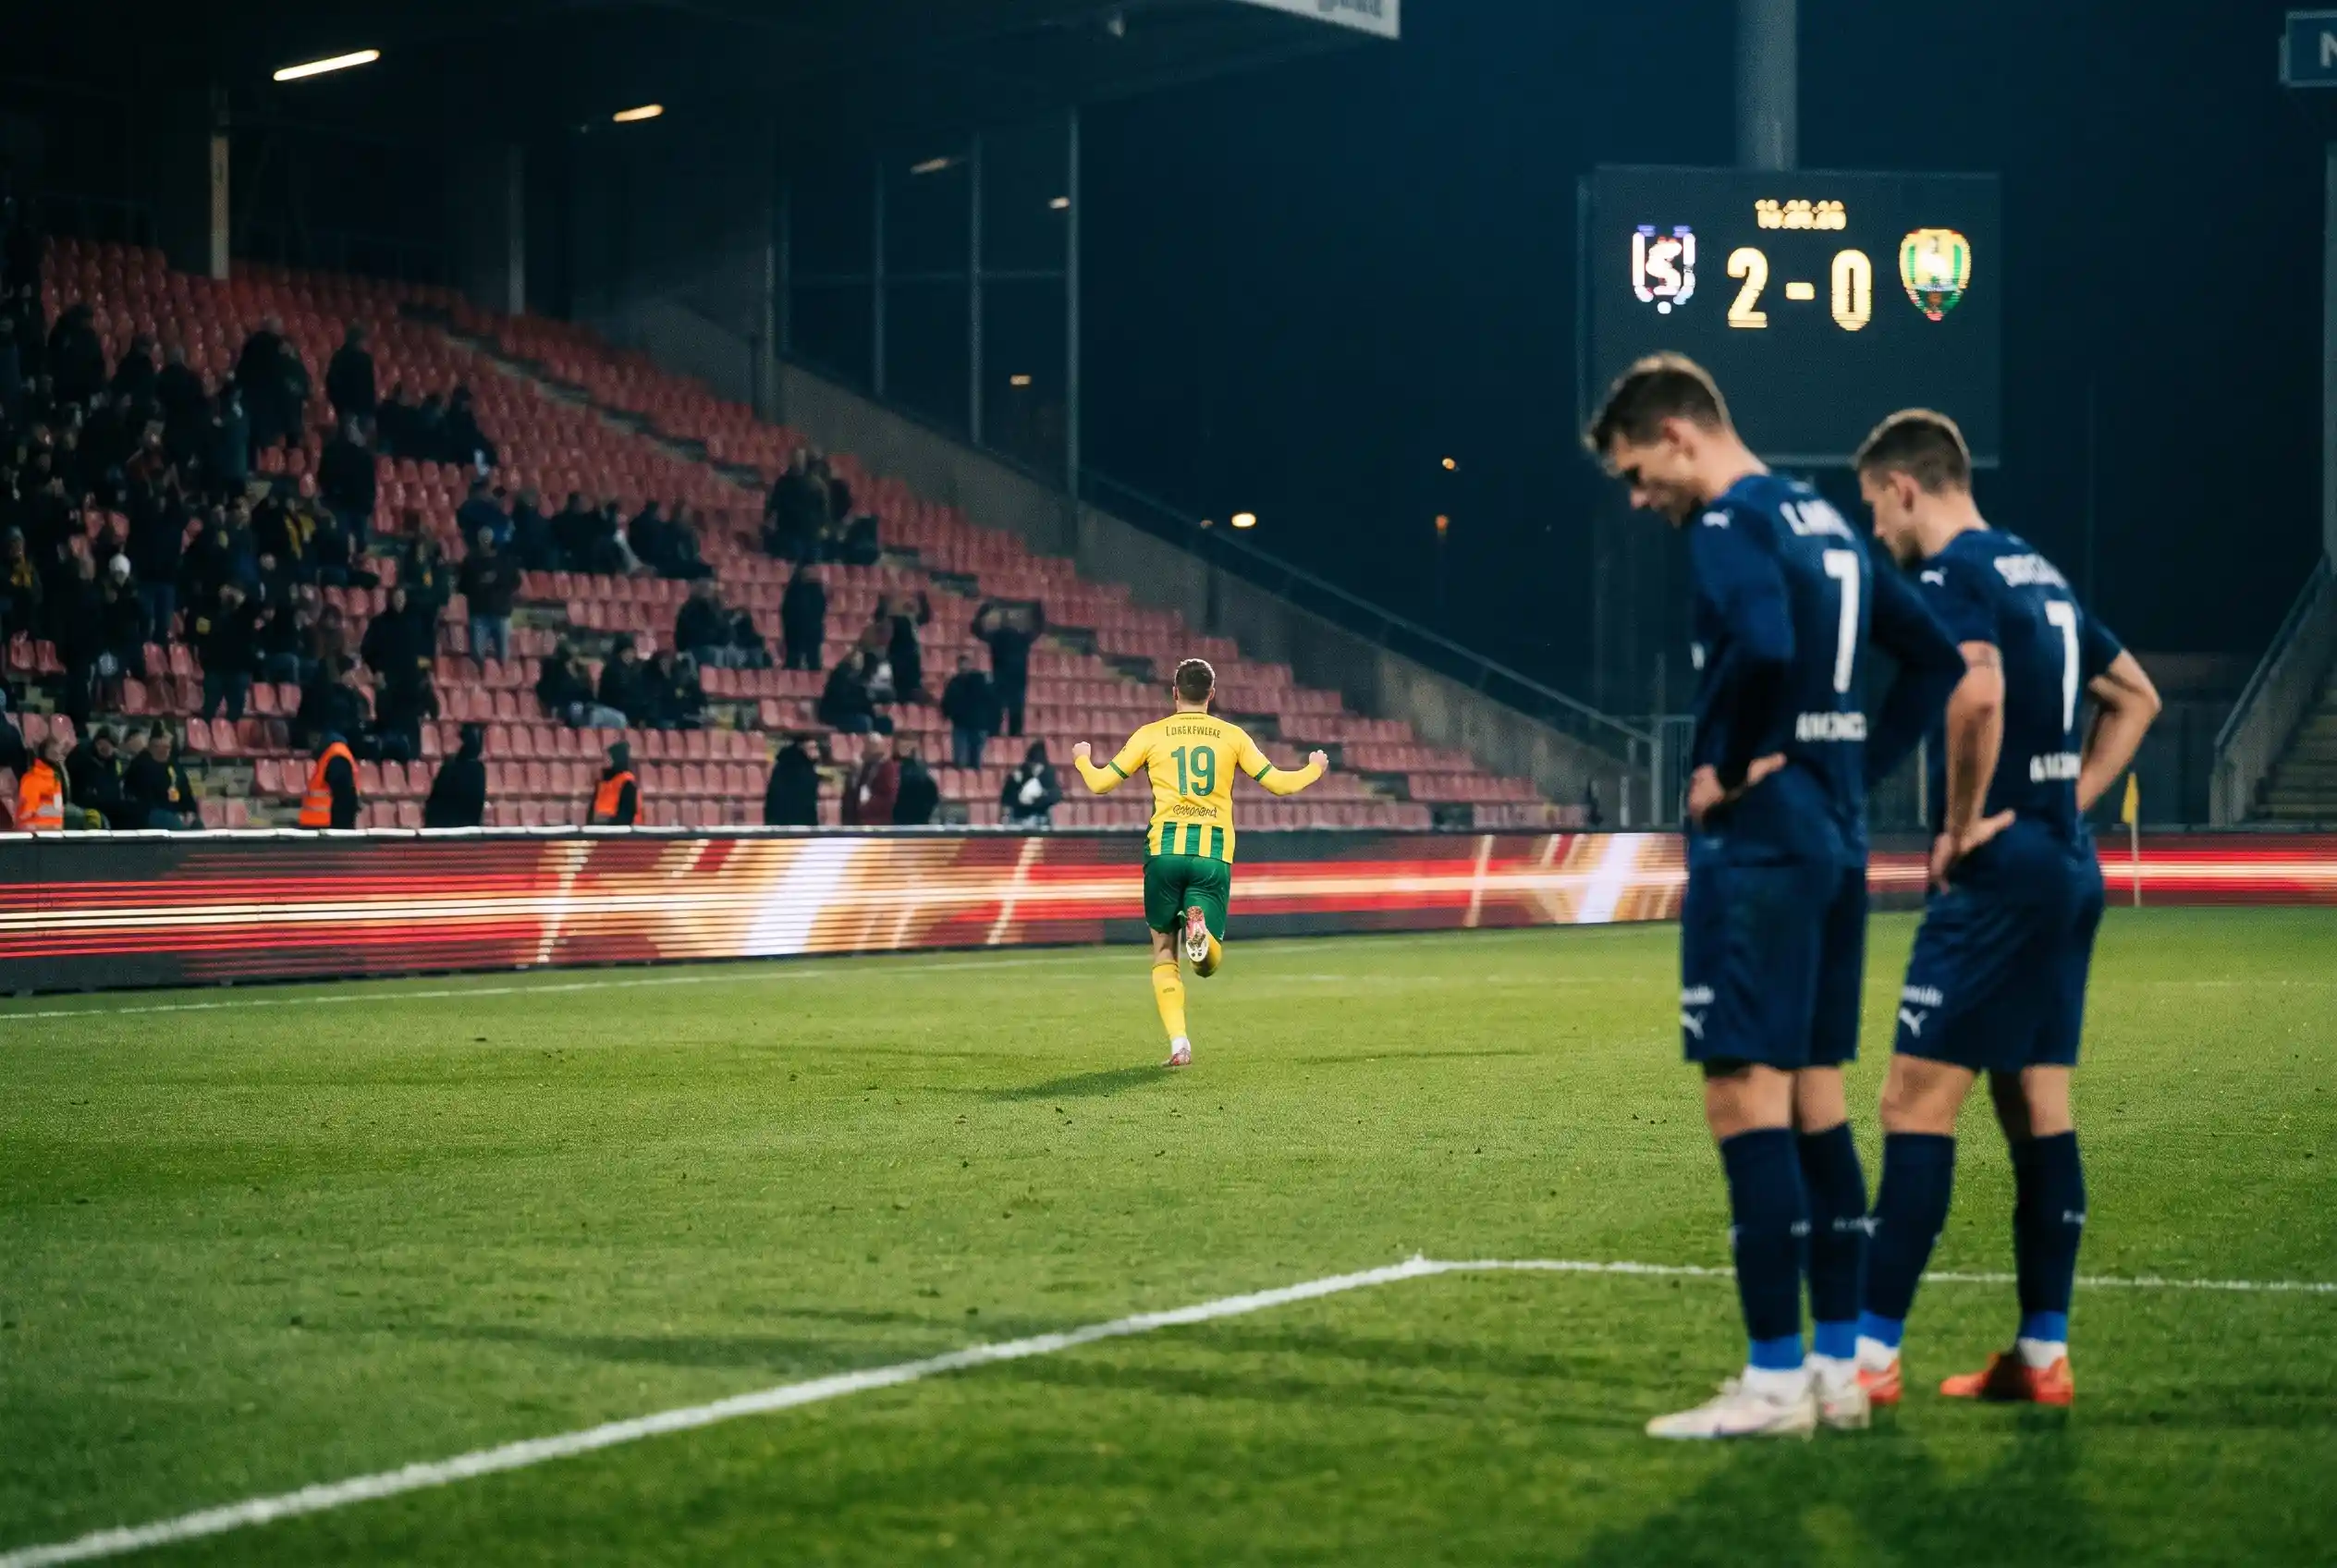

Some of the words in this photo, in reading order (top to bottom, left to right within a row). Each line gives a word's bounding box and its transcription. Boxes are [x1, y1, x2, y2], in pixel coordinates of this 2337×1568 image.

[1727, 247, 1768, 328] 2
[1830, 249, 1872, 331] 0
[1822, 549, 1860, 694] 7
[2044, 600, 2080, 735] 7
[1170, 745, 1216, 797] 19
